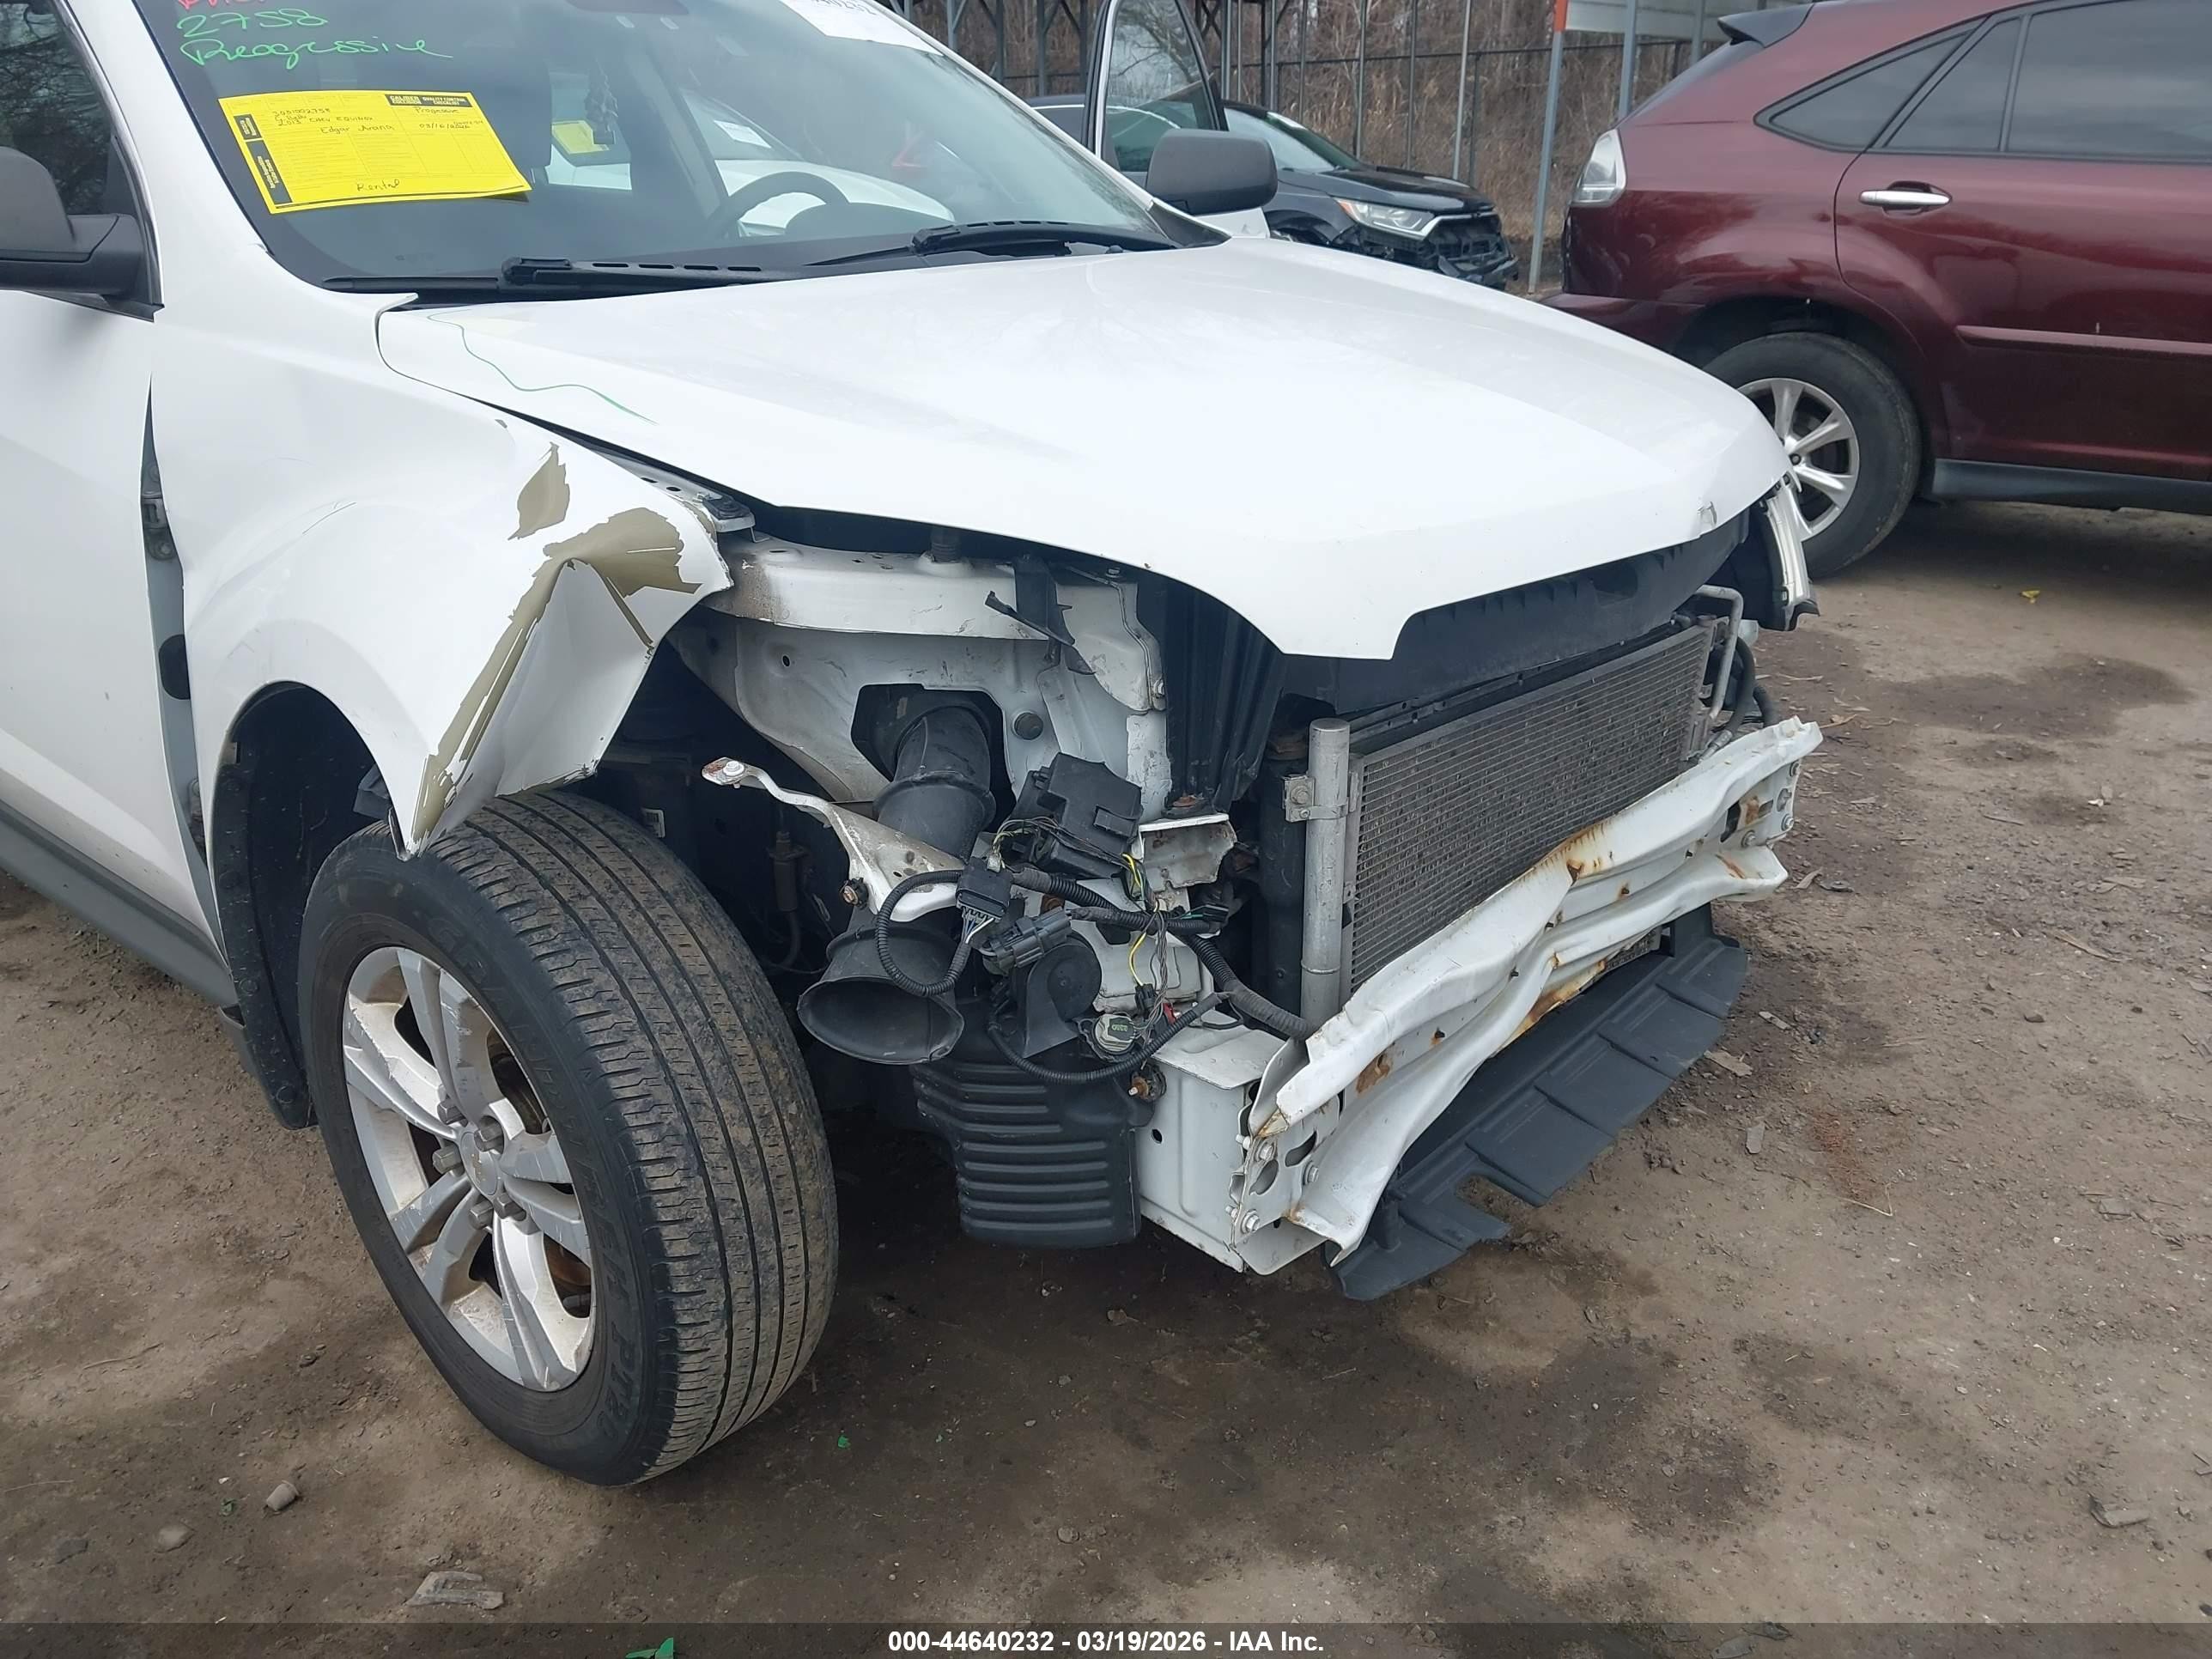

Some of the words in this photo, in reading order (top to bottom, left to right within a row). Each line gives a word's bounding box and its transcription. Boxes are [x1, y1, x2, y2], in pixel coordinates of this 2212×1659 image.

[177, 8, 328, 37] 2758
[320, 125, 350, 135] Edgar
[356, 179, 401, 191] Rental
